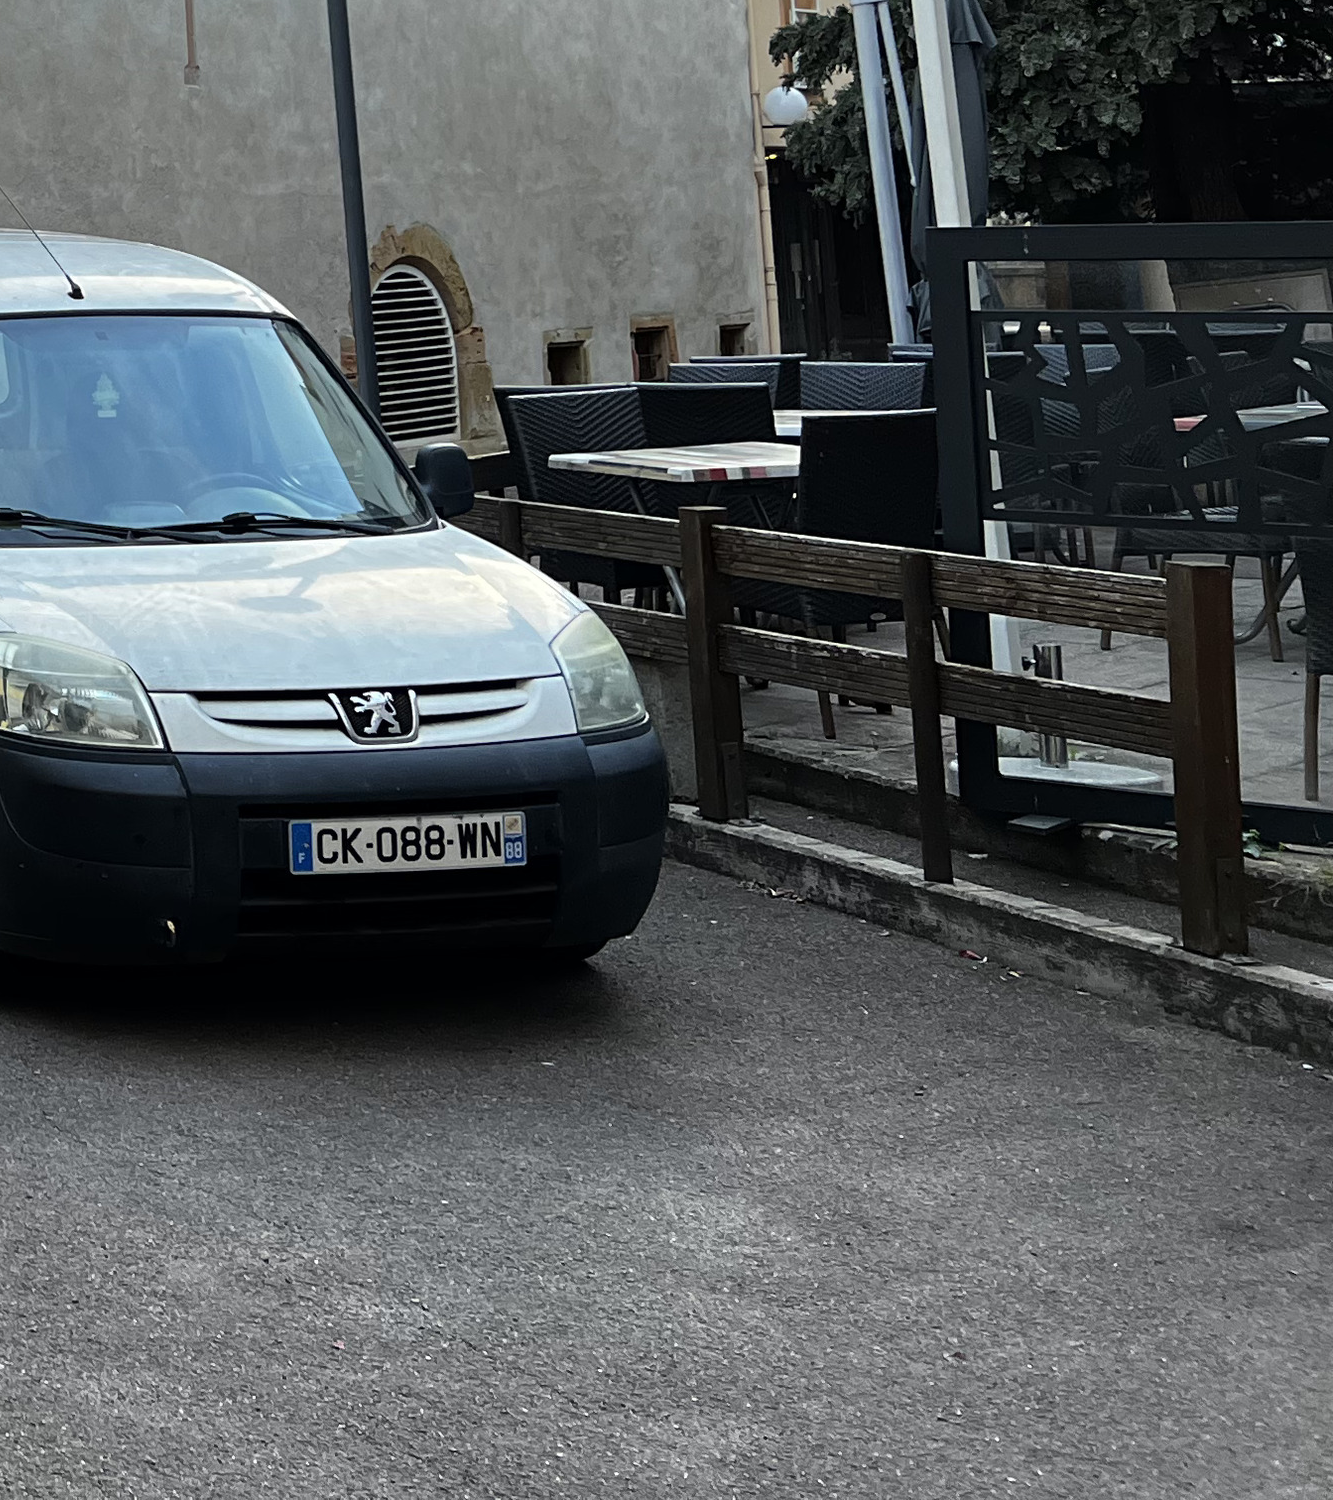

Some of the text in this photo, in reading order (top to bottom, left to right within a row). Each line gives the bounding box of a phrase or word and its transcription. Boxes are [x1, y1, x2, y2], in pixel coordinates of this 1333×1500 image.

[316, 821, 502, 864] CK-088-WN
[505, 841, 523, 859] 88
[298, 852, 305, 864] F
